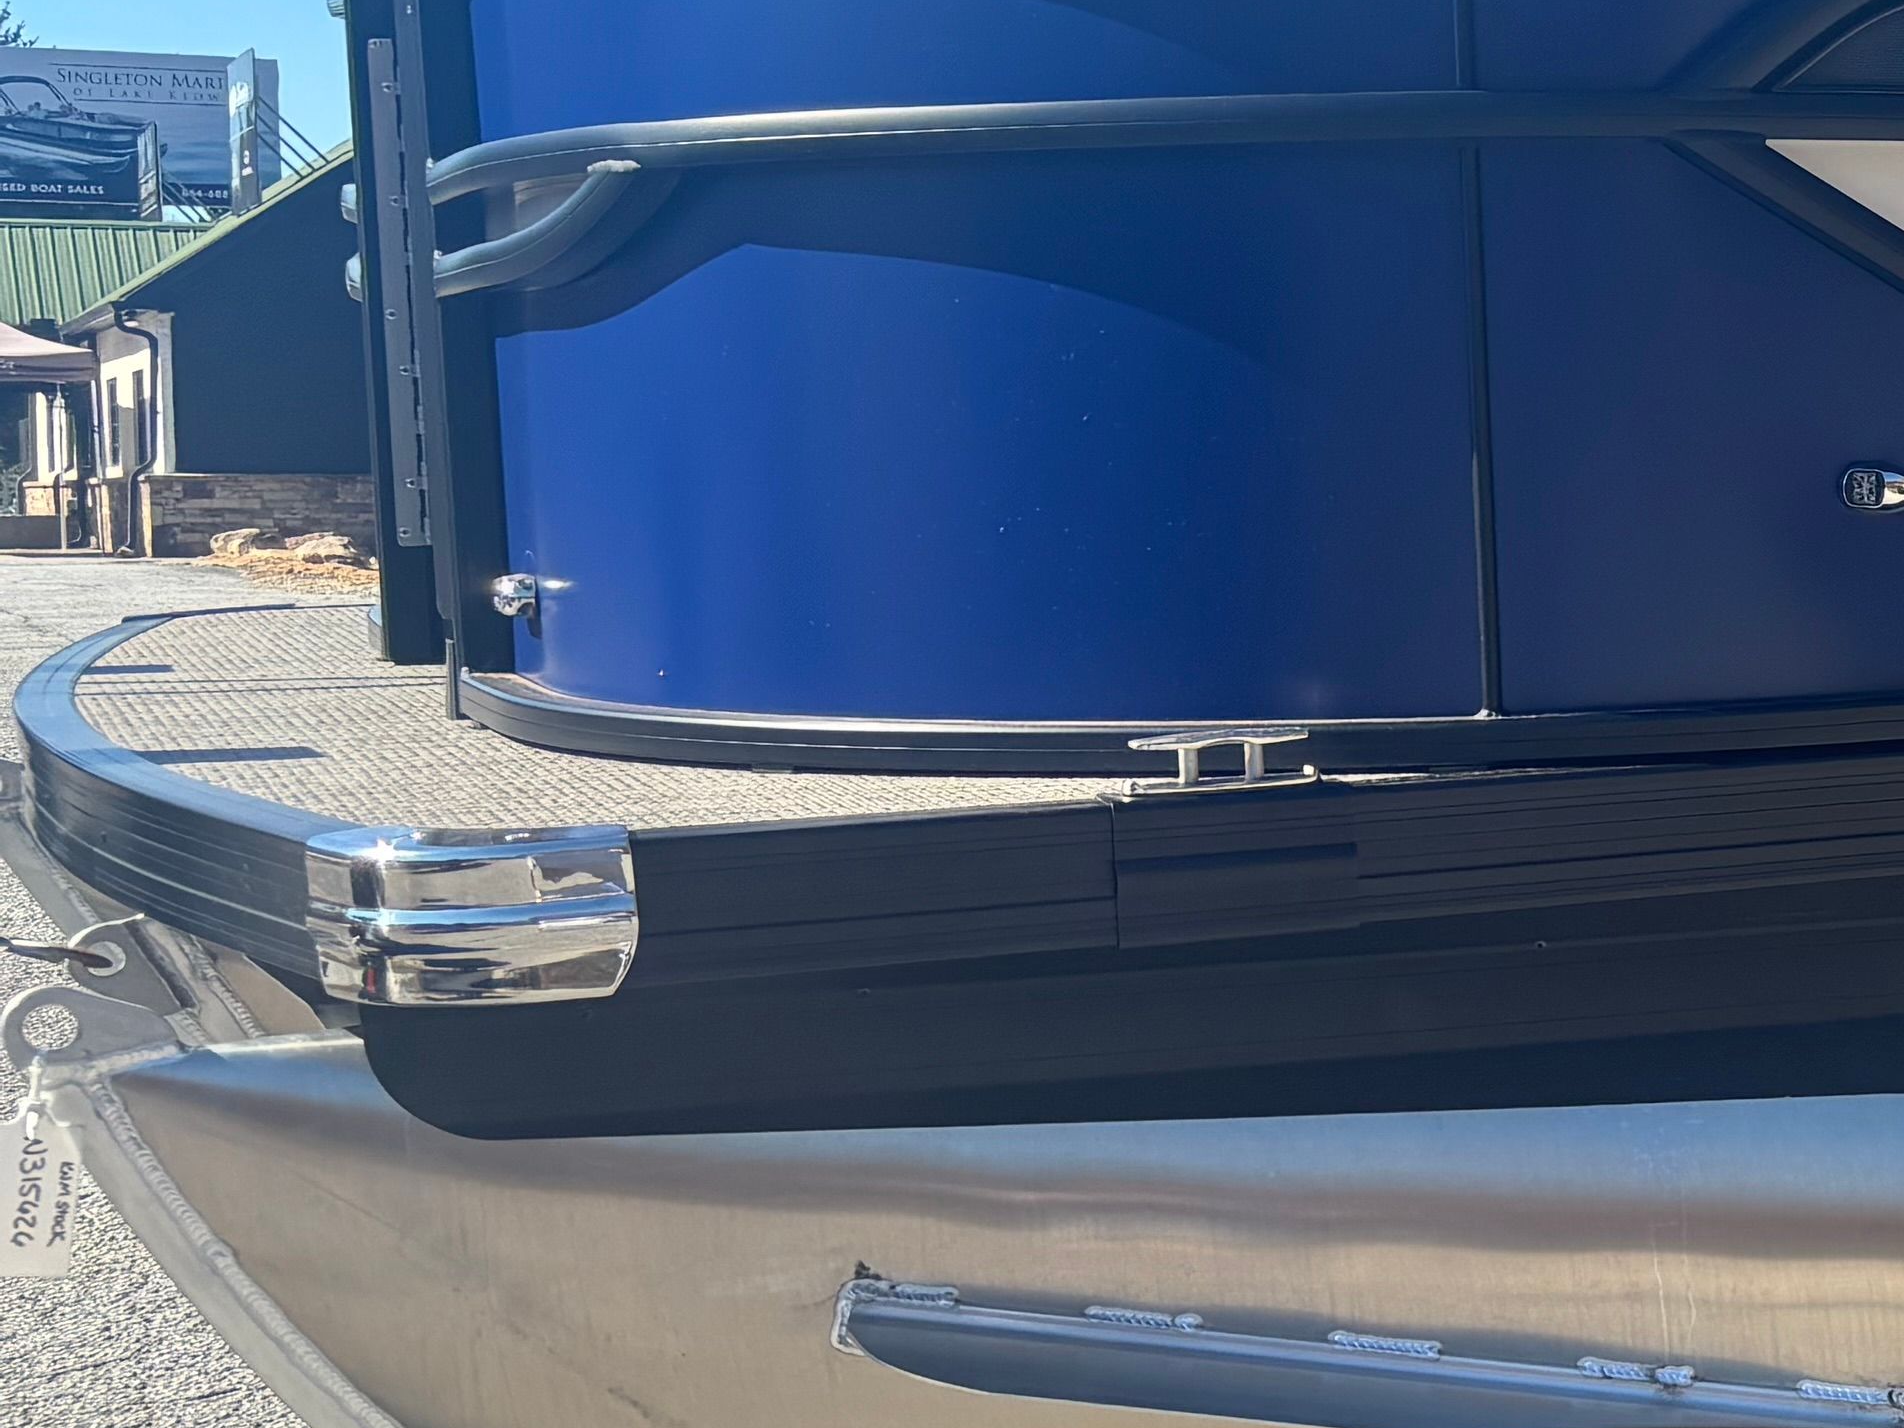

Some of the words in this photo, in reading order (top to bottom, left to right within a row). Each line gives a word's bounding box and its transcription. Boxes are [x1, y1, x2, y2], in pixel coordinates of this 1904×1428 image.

[57, 68, 163, 87] SINGLETON
[172, 73, 226, 90] MARI
[30, 183, 62, 194] BOAT
[67, 184, 104, 195] SALES
